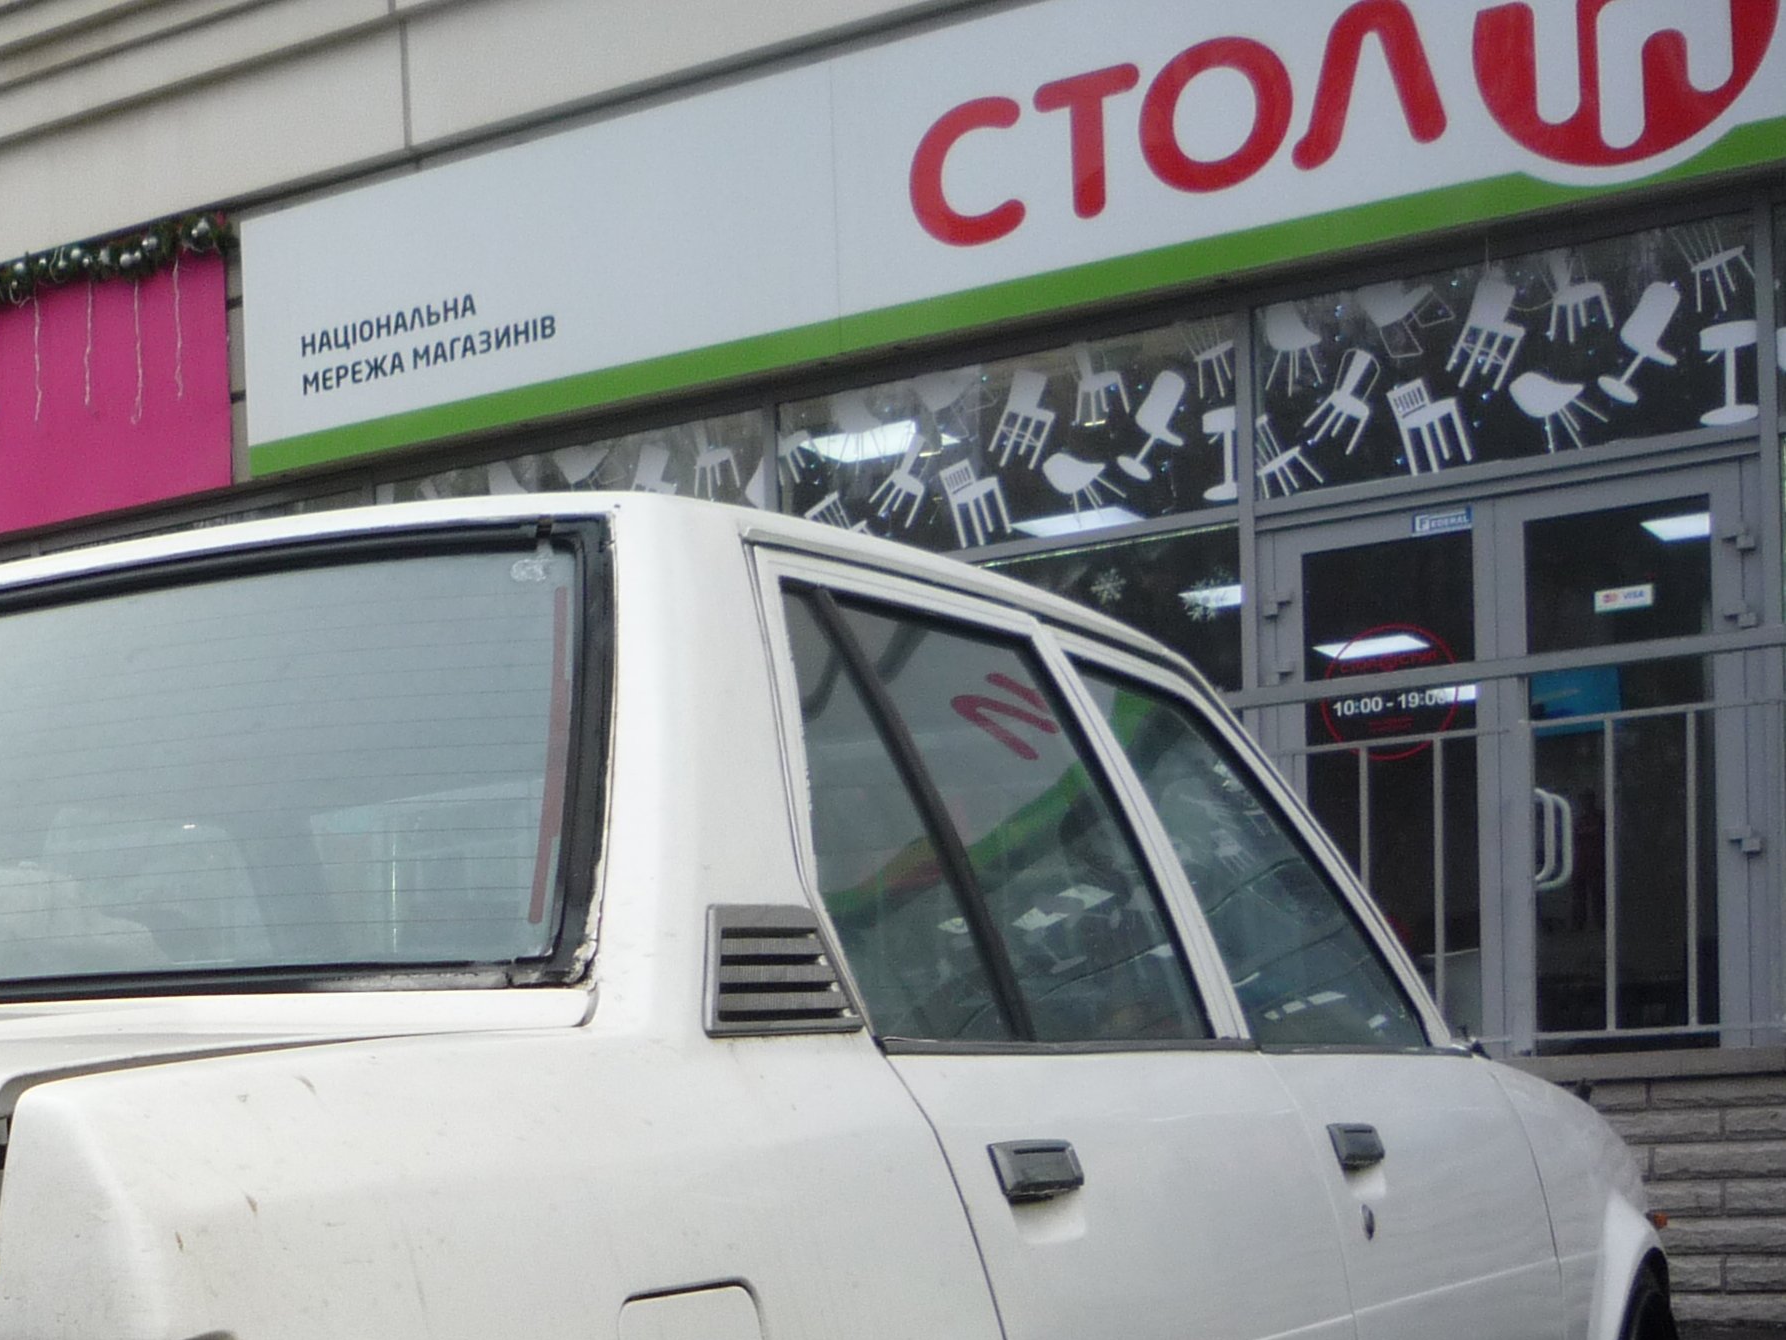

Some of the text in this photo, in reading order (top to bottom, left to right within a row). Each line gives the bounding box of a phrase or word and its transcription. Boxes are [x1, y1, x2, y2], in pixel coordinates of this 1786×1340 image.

[301, 293, 476, 357] НАЦІОНАЛЬНА
[303, 315, 557, 395] МЕРЕЖА МАГАЗИНІВ
[1333, 697, 1382, 717] 10:00
